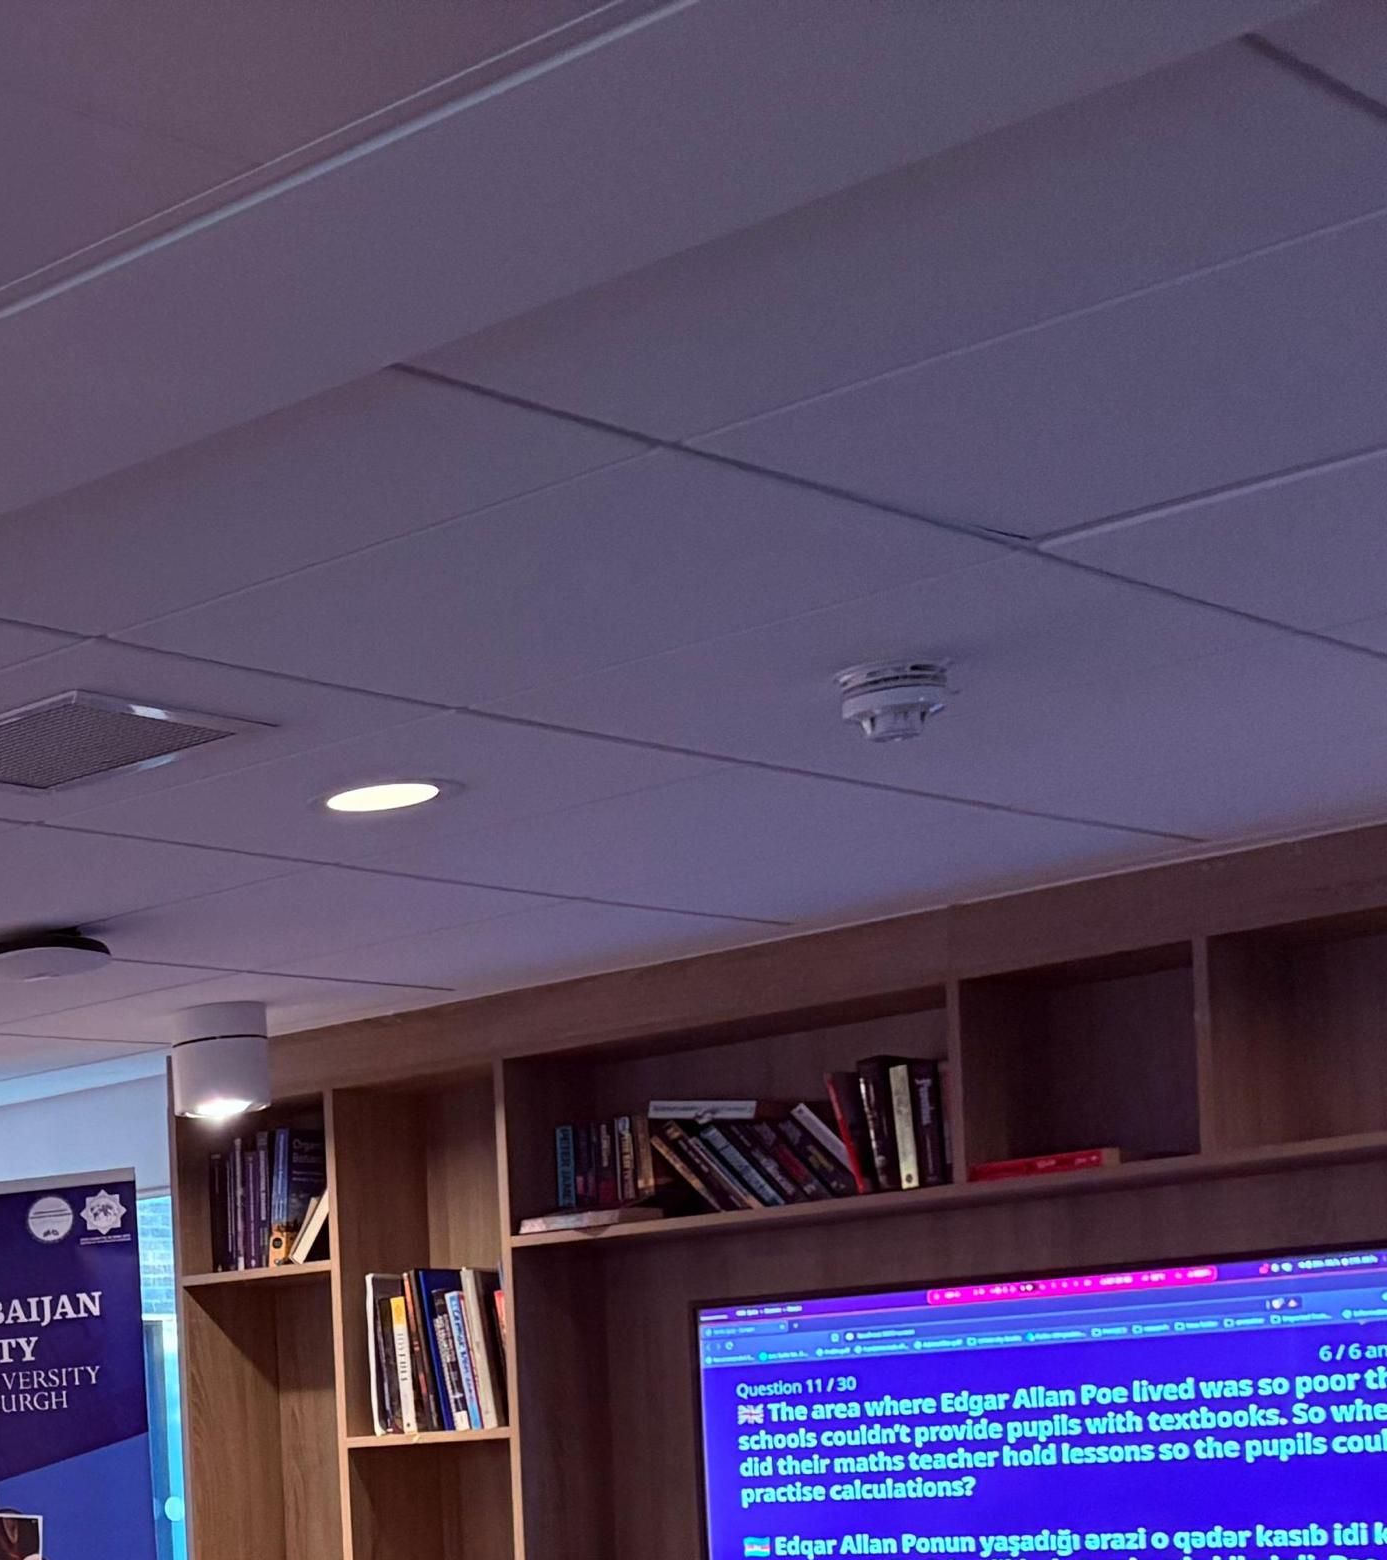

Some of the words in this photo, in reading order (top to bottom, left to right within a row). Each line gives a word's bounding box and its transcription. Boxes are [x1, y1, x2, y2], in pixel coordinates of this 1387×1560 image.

[1318, 1345, 1333, 1362] 6
[1335, 1344, 1346, 1361] /
[1348, 1343, 1362, 1360] 6
[1365, 1344, 1387, 1359] an
[736, 1379, 802, 1400] Question
[806, 1379, 822, 1394] 11
[826, 1378, 834, 1393] /
[837, 1376, 857, 1392] 30
[767, 1402, 808, 1422] The
[811, 1403, 861, 1419] area
[864, 1394, 938, 1418] where
[941, 1390, 1010, 1416] Edgar
[1012, 1385, 1076, 1409] Allan
[1080, 1384, 1129, 1405] Poe
[1132, 1376, 1196, 1402] lived
[1199, 1379, 1254, 1399] was
[1258, 1376, 1290, 1396] so
[1295, 1372, 1361, 1400] poor
[738, 1428, 818, 1451] schools
[820, 1424, 911, 1447] couldn't
[914, 1418, 1003, 1448] provide
[1007, 1413, 1082, 1443] pupils
[1085, 1410, 1144, 1435] with
[1147, 1404, 1288, 1433] textbooks.
[1291, 1403, 1326, 1424] So
[1330, 1398, 1387, 1423] whe
[739, 1456, 773, 1477] did
[777, 1453, 831, 1475] their
[833, 1451, 906, 1474] maths
[909, 1448, 999, 1471] teacher
[1002, 1443, 1057, 1467] hold
[1062, 1442, 1155, 1464] lessons
[1158, 1440, 1190, 1461] so
[1193, 1436, 1240, 1460] the
[1245, 1432, 1327, 1463] pupils
[740, 1481, 825, 1508] practise
[829, 1476, 976, 1501] calculations?
[774, 1535, 838, 1560] Edqar
[840, 1533, 897, 1555] Allan
[901, 1533, 976, 1554] Ponun
[979, 1528, 1080, 1557] yaşadığı
[1085, 1527, 1147, 1550] ərazi
[1150, 1532, 1169, 1550] o
[1173, 1525, 1252, 1554] qədər
[1255, 1523, 1328, 1548] kasıb
[1333, 1522, 1369, 1546] idi
